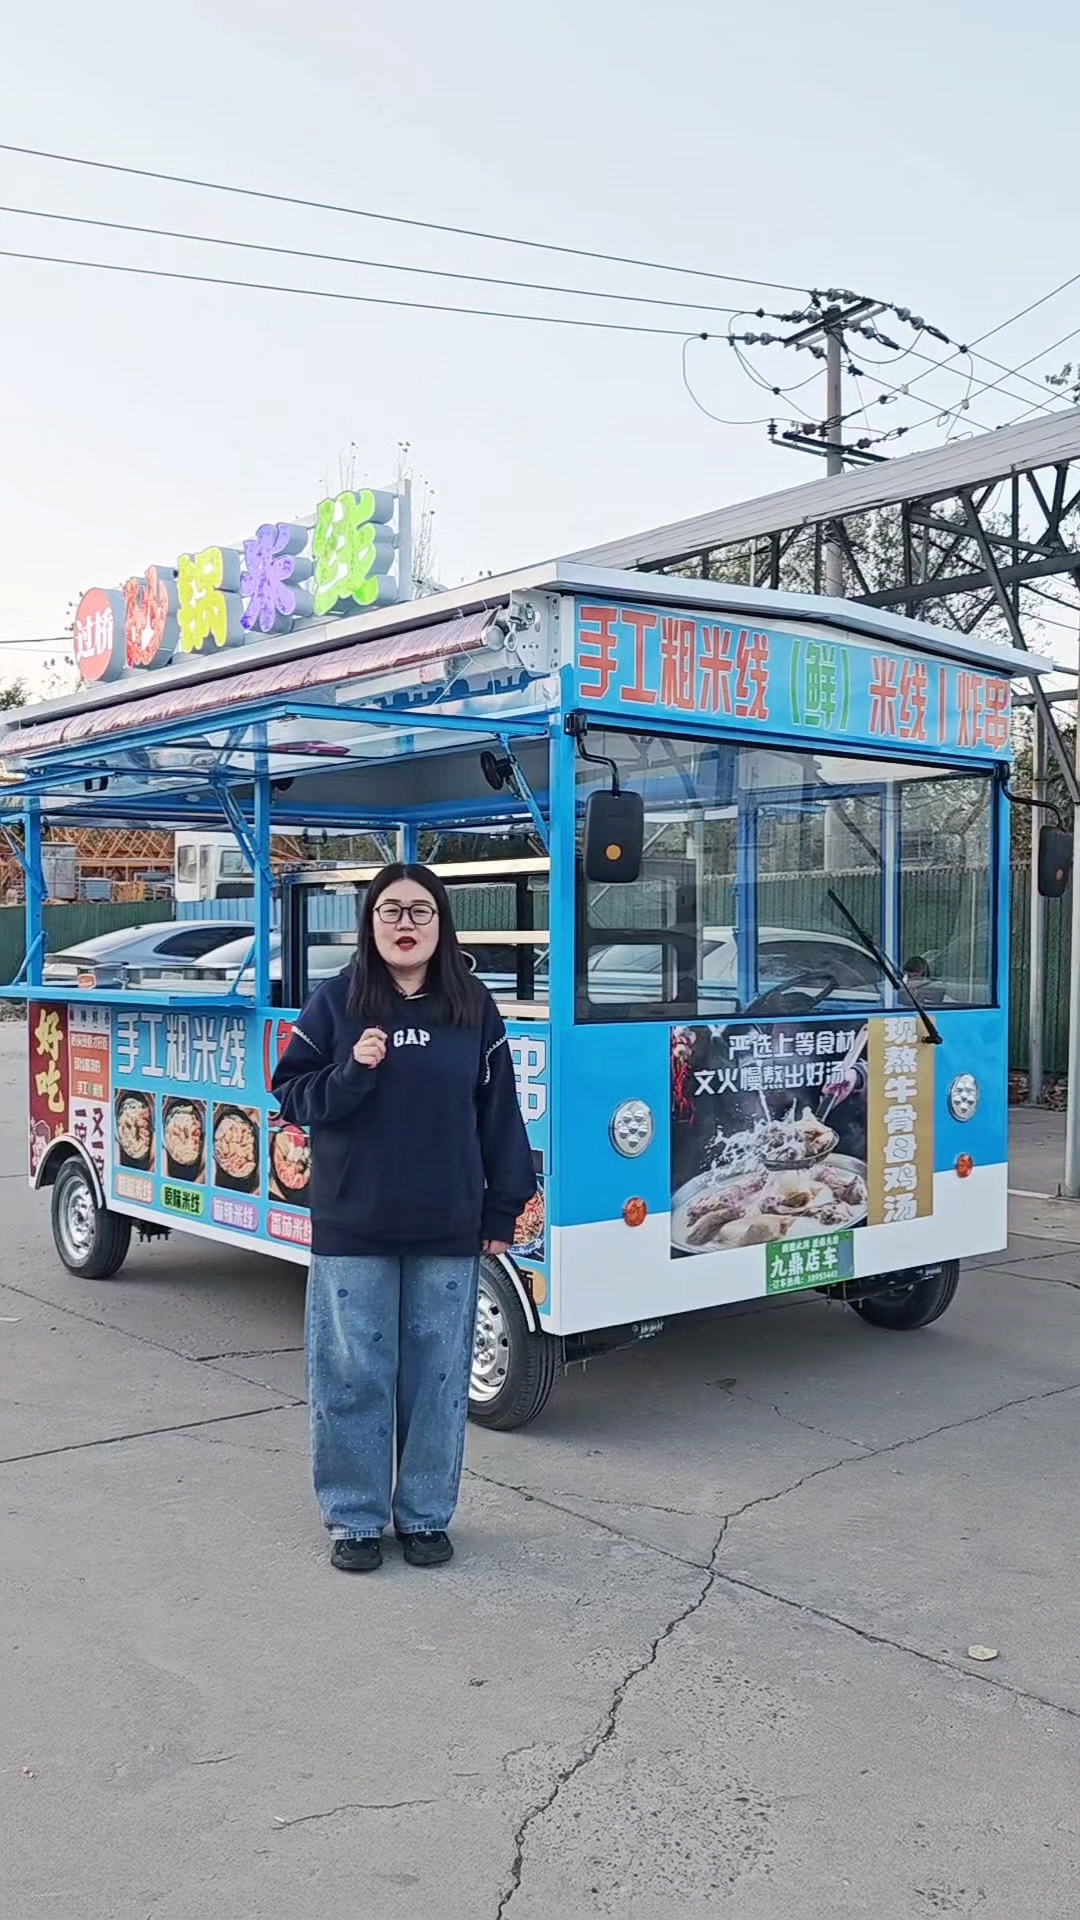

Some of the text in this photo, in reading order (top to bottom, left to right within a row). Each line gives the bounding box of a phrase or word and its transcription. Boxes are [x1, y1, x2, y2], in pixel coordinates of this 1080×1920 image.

[74, 607, 113, 658] 过桥
[117, 1012, 247, 1089] 手工粗米线
[393, 1028, 431, 1048] GAP
[728, 1030, 856, 1060] 严选上等食材
[34, 1008, 65, 1113] 好吃
[693, 1060, 846, 1096] 文火慢熬出好汤
[883, 1017, 918, 1223] 现熬牛骨母鸡汤
[163, 1186, 201, 1215] 原味米线
[770, 1246, 838, 1278] 九鼎店车
